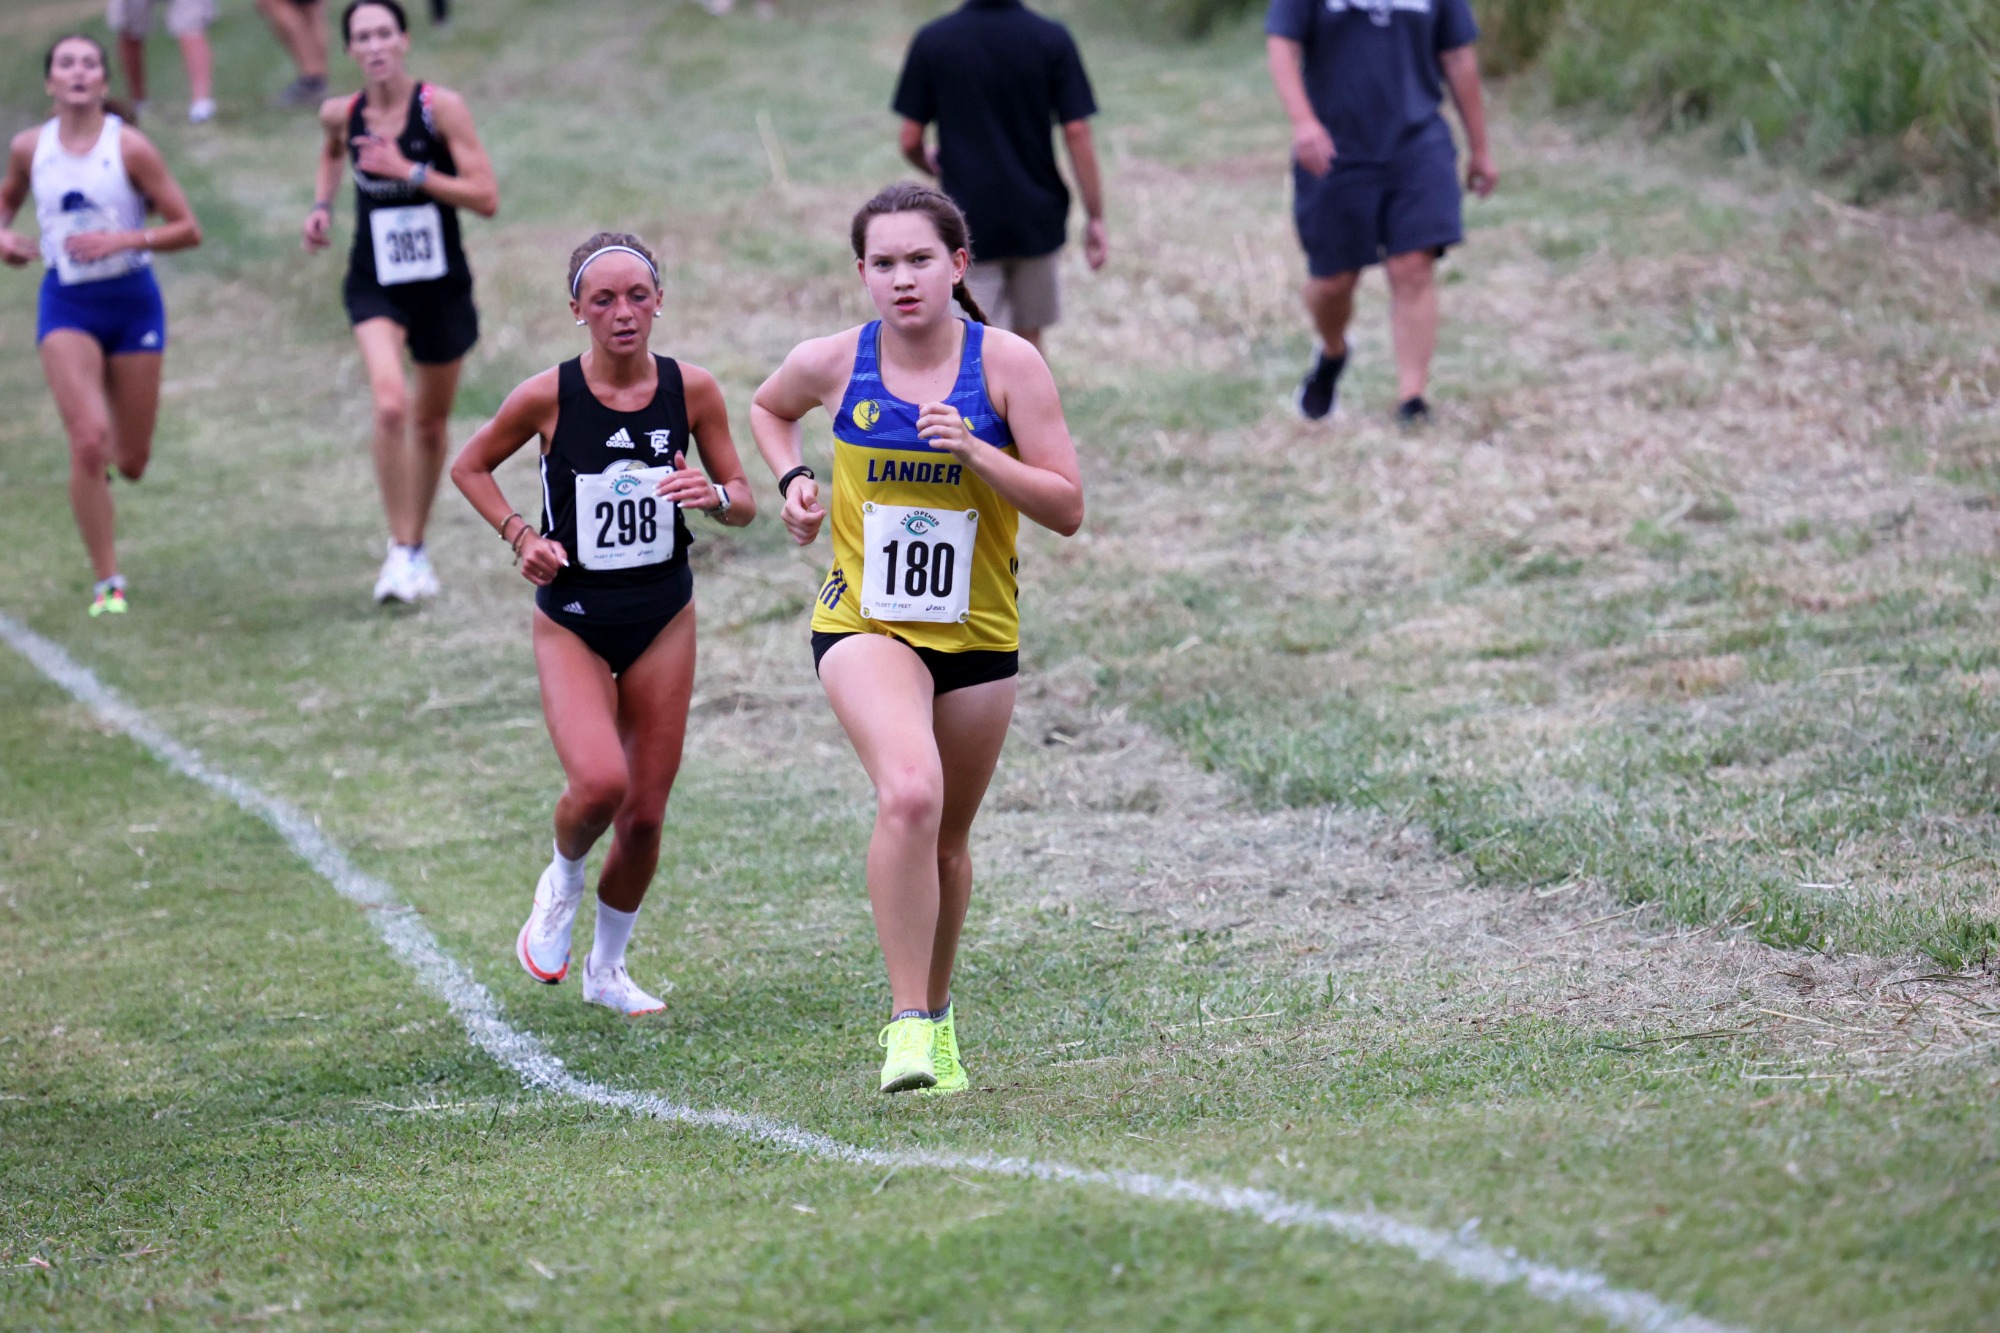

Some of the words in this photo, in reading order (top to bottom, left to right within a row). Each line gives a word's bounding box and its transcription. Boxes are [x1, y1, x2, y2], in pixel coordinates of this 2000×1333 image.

[605, 440, 635, 449] adidas
[866, 459, 963, 486] LANDER
[595, 497, 657, 548] 298
[900, 513, 911, 526] EYE
[914, 510, 940, 527] OPENER
[882, 540, 955, 598] 180
